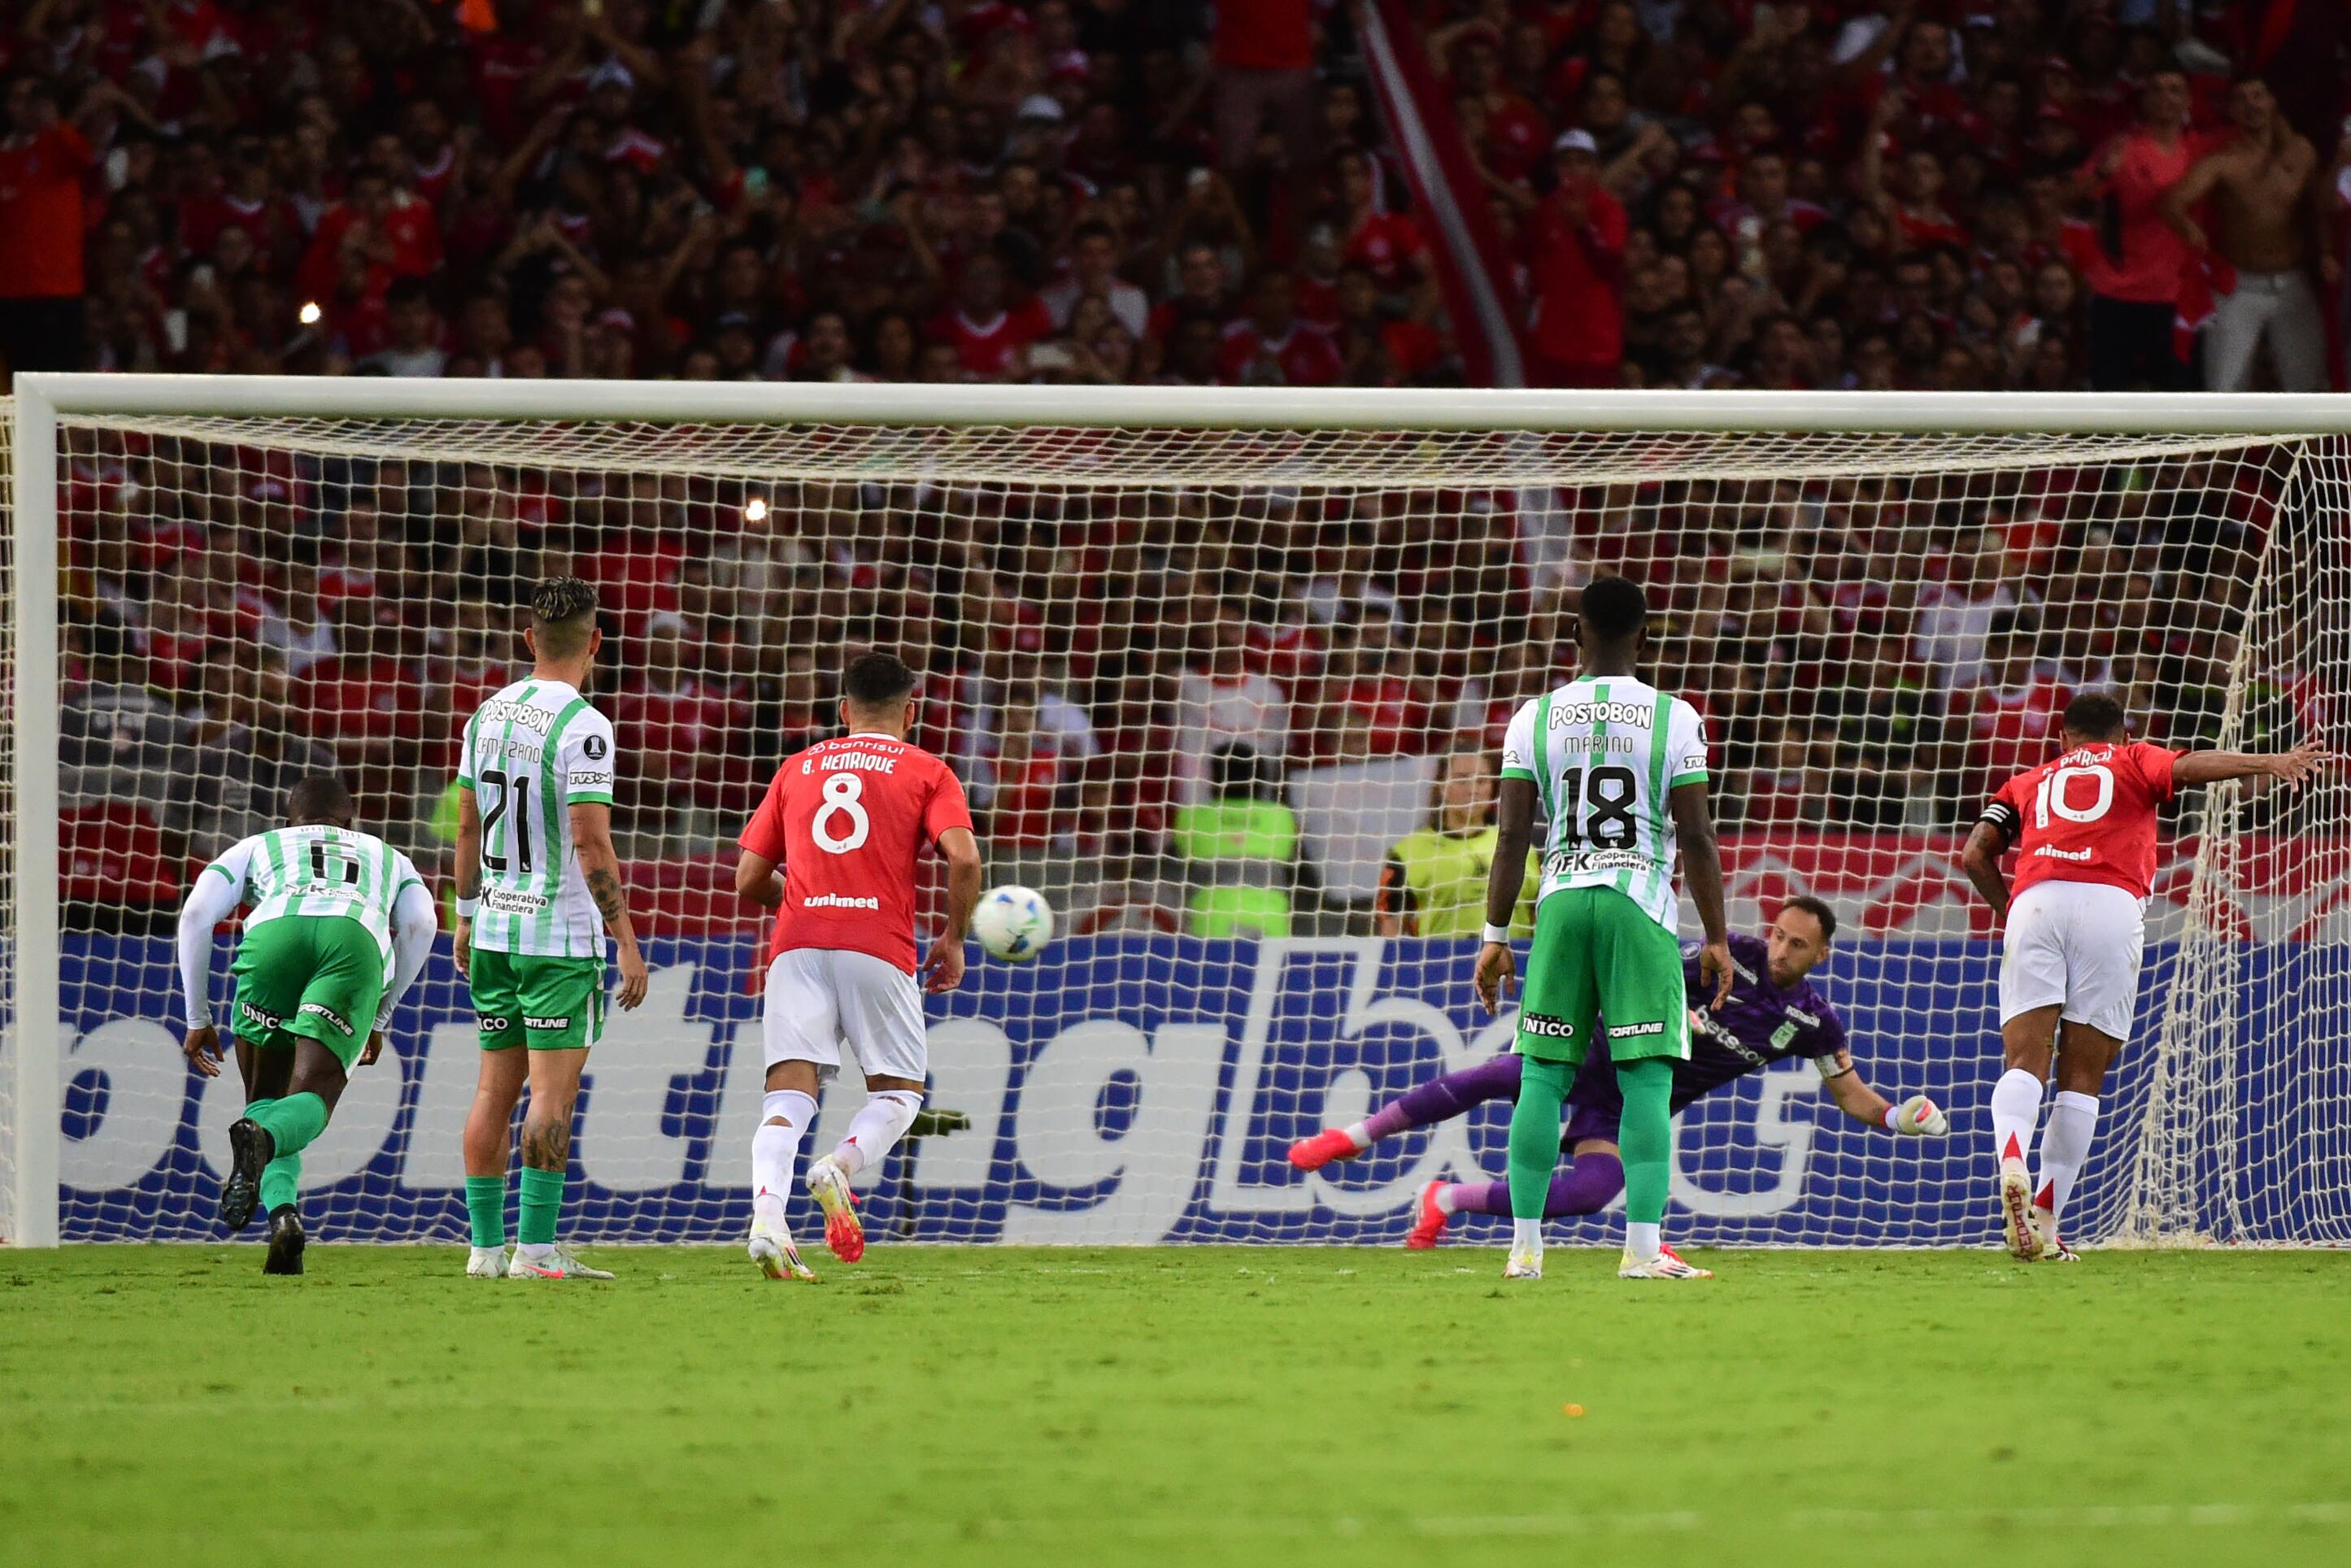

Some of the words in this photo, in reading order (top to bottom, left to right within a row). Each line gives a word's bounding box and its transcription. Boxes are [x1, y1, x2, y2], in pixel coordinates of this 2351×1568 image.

[481, 699, 555, 737] POSTOBON
[1550, 701, 1652, 730] POSTOBON
[828, 740, 905, 755] banrisul
[1565, 736, 1633, 753] MARINO
[802, 759, 815, 775] B.
[821, 751, 897, 774] HENRIQUE
[1561, 766, 1637, 850] 18
[2035, 765, 2114, 829] 10
[481, 769, 532, 873] 21
[812, 772, 869, 854] 8
[2034, 843, 2092, 860] nimed
[492, 899, 533, 915] Financiera
[493, 889, 546, 907] Cooperativa
[242, 1001, 279, 1030] UNIC
